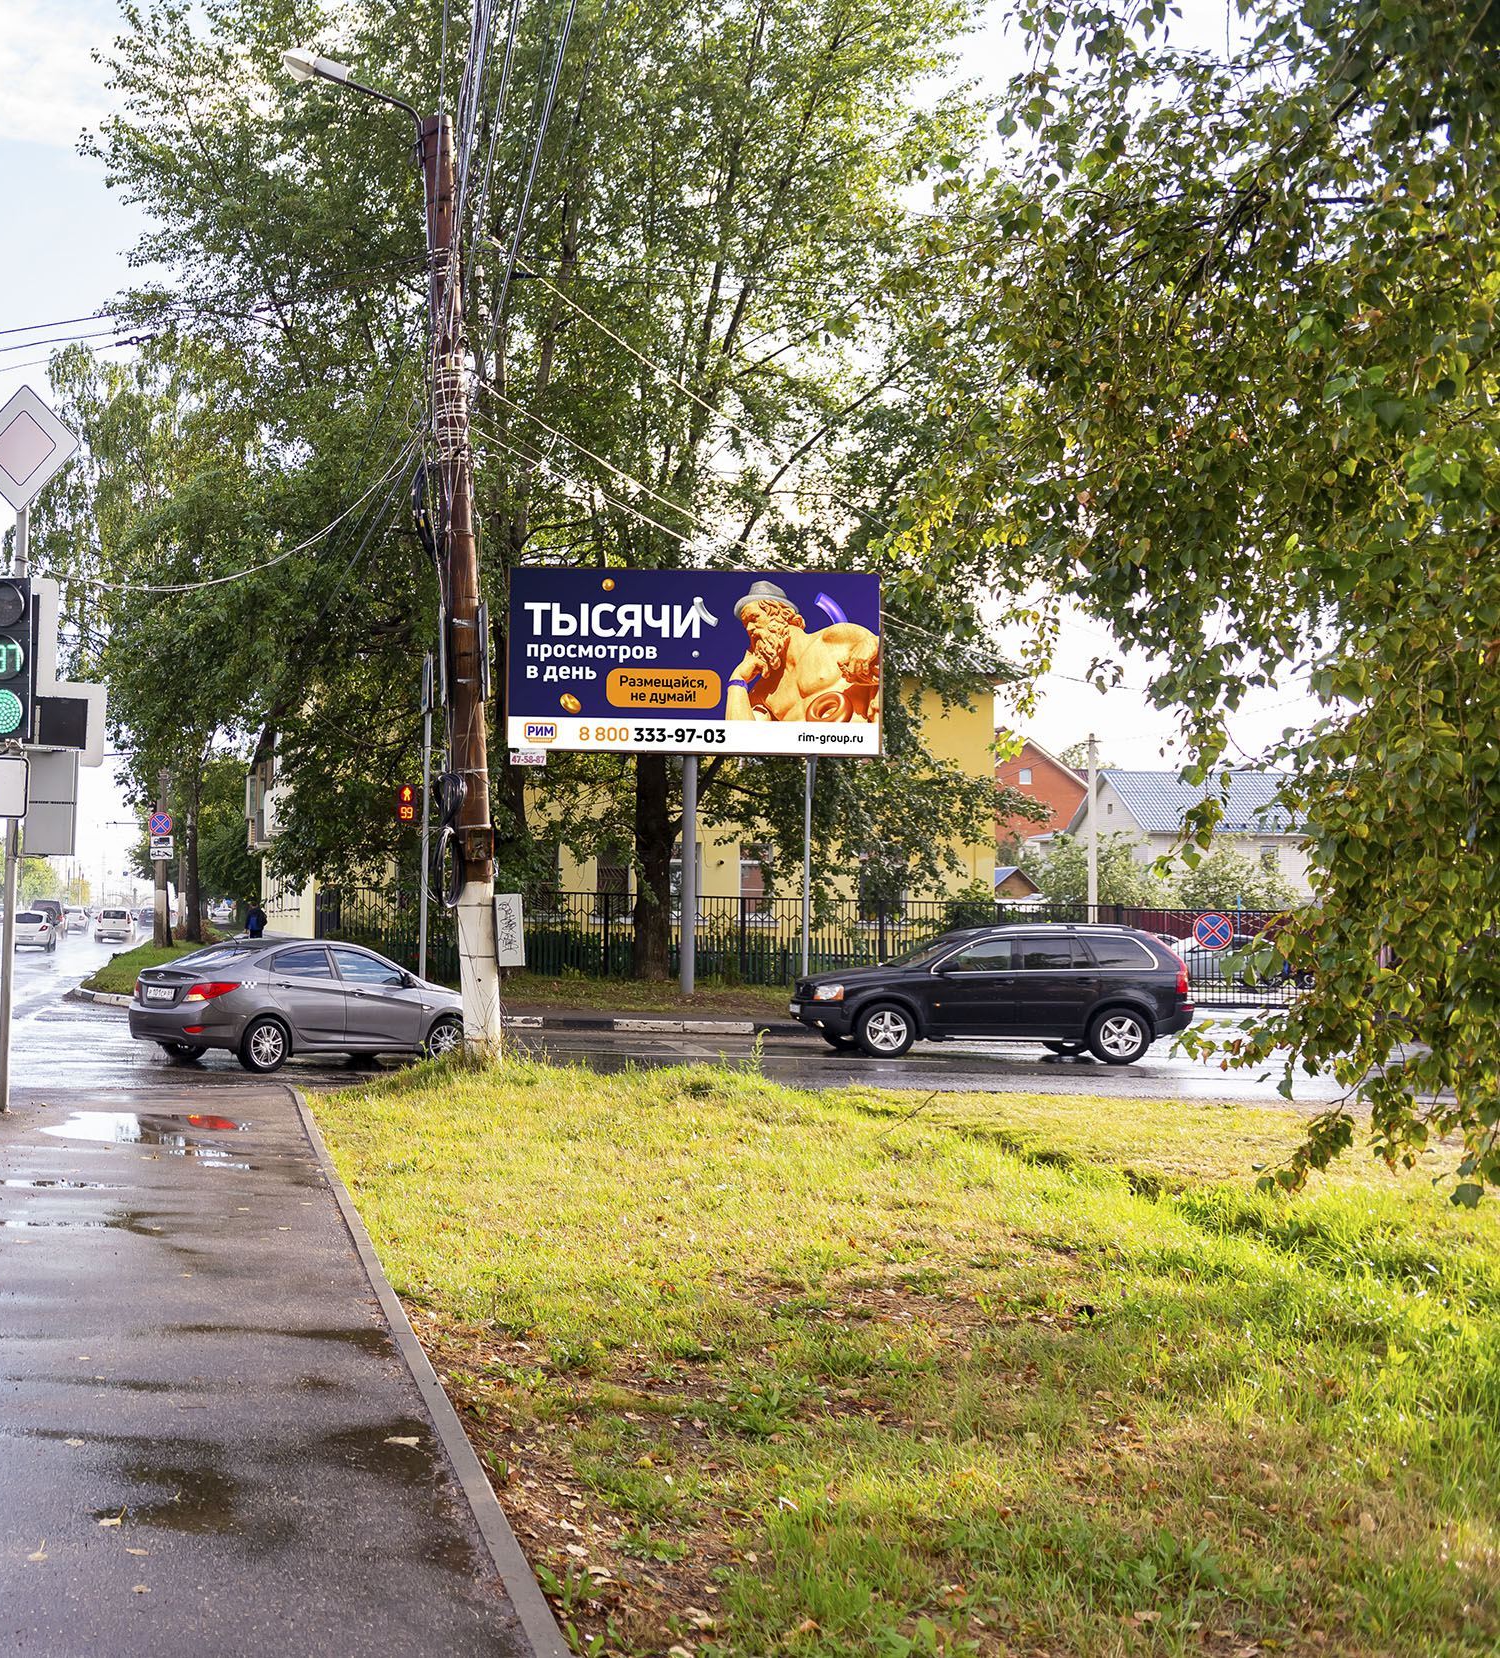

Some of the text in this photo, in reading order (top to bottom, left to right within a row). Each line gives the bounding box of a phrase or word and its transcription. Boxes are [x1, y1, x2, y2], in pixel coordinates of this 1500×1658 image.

[524, 601, 701, 639] ТЫСЯЧИ
[526, 643, 658, 663] просмотров
[526, 665, 597, 682] в день
[619, 675, 708, 690] Размещайся,
[630, 690, 697, 705] не думай!
[527, 725, 554, 737] РИМ
[579, 726, 726, 743] 8 800 333-97-03
[797, 732, 864, 745] rim-group.ru
[400, 806, 414, 819] 99
